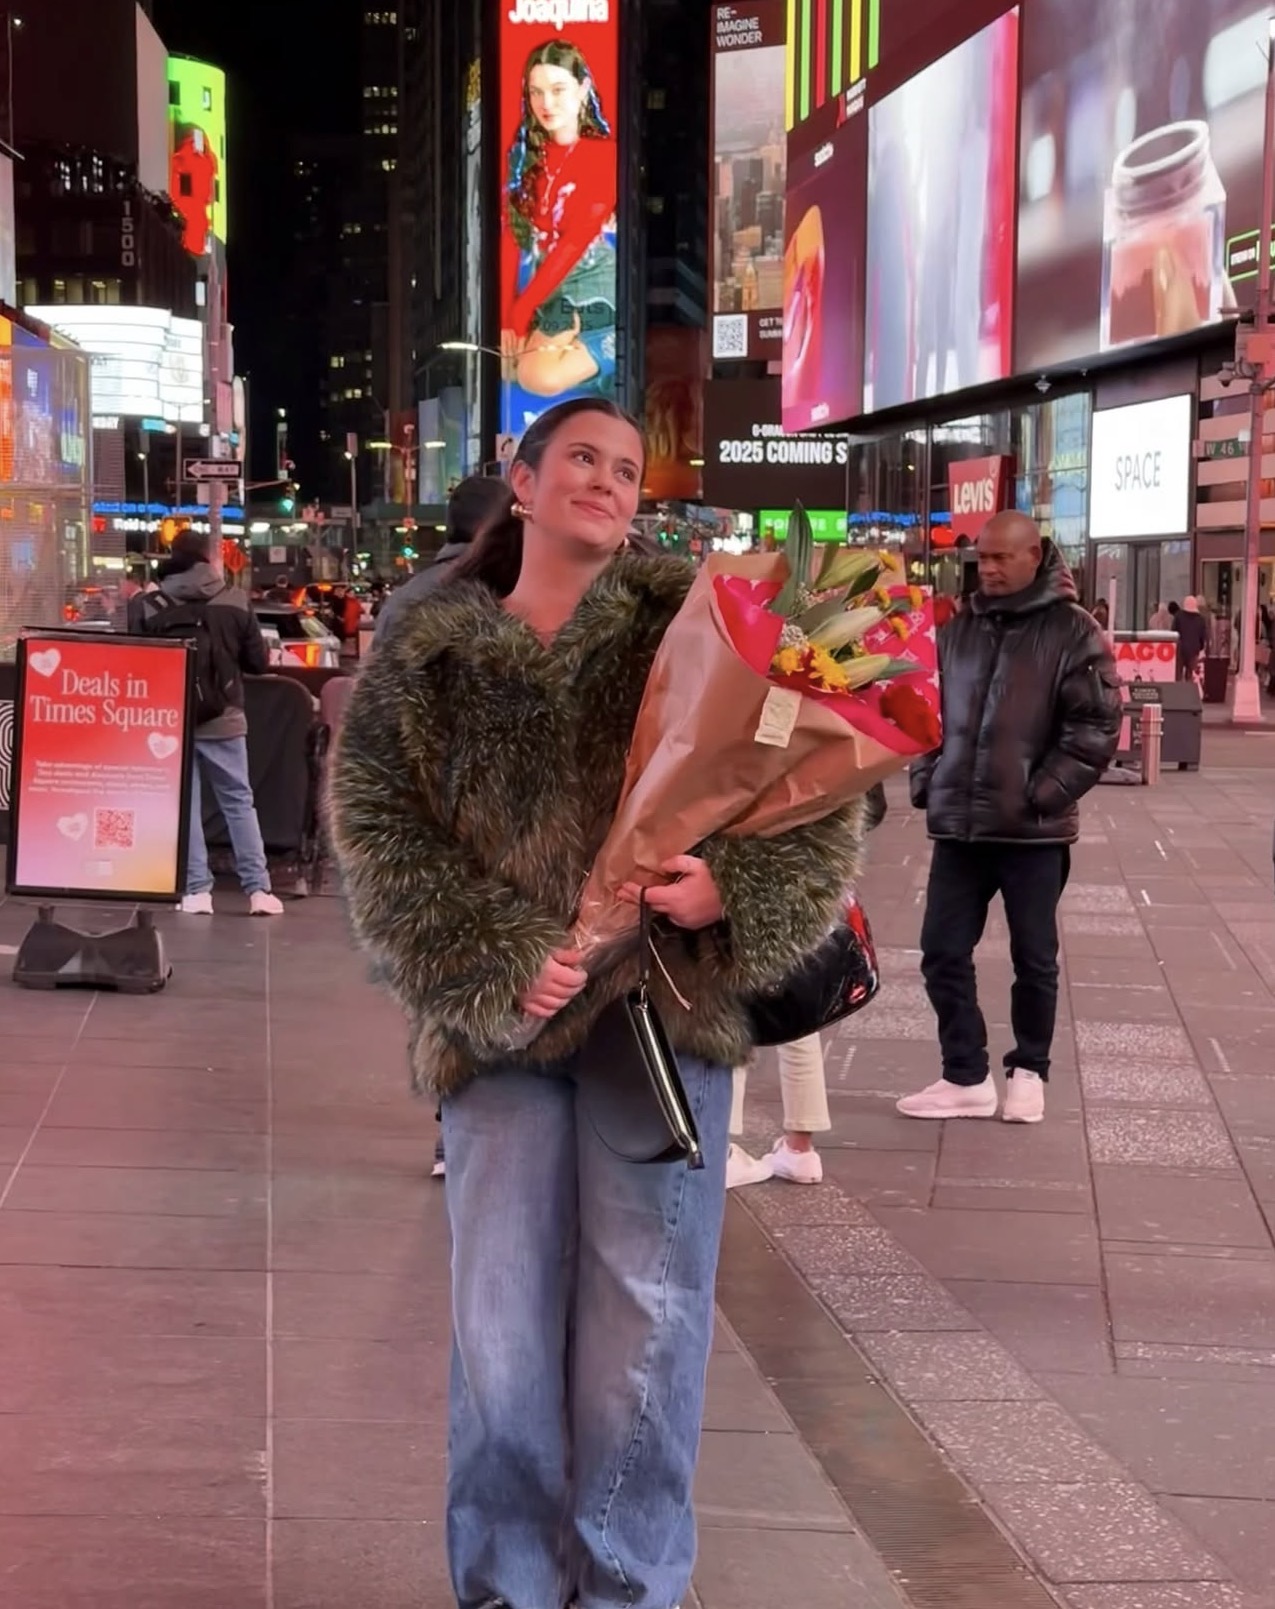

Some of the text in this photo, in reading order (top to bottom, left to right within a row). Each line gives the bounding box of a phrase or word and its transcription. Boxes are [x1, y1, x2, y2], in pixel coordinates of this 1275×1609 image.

[716, 17, 759, 33] IMAGINE
[717, 7, 737, 20] RE-
[716, 30, 762, 47] WONDER
[122, 201, 134, 267] 1500
[719, 440, 763, 463] 2025
[766, 441, 833, 464] COMING
[1220, 441, 1234, 456] 46
[1114, 451, 1161, 490] SPACE
[61, 669, 149, 699] Deals in
[30, 695, 179, 733] Times Square
